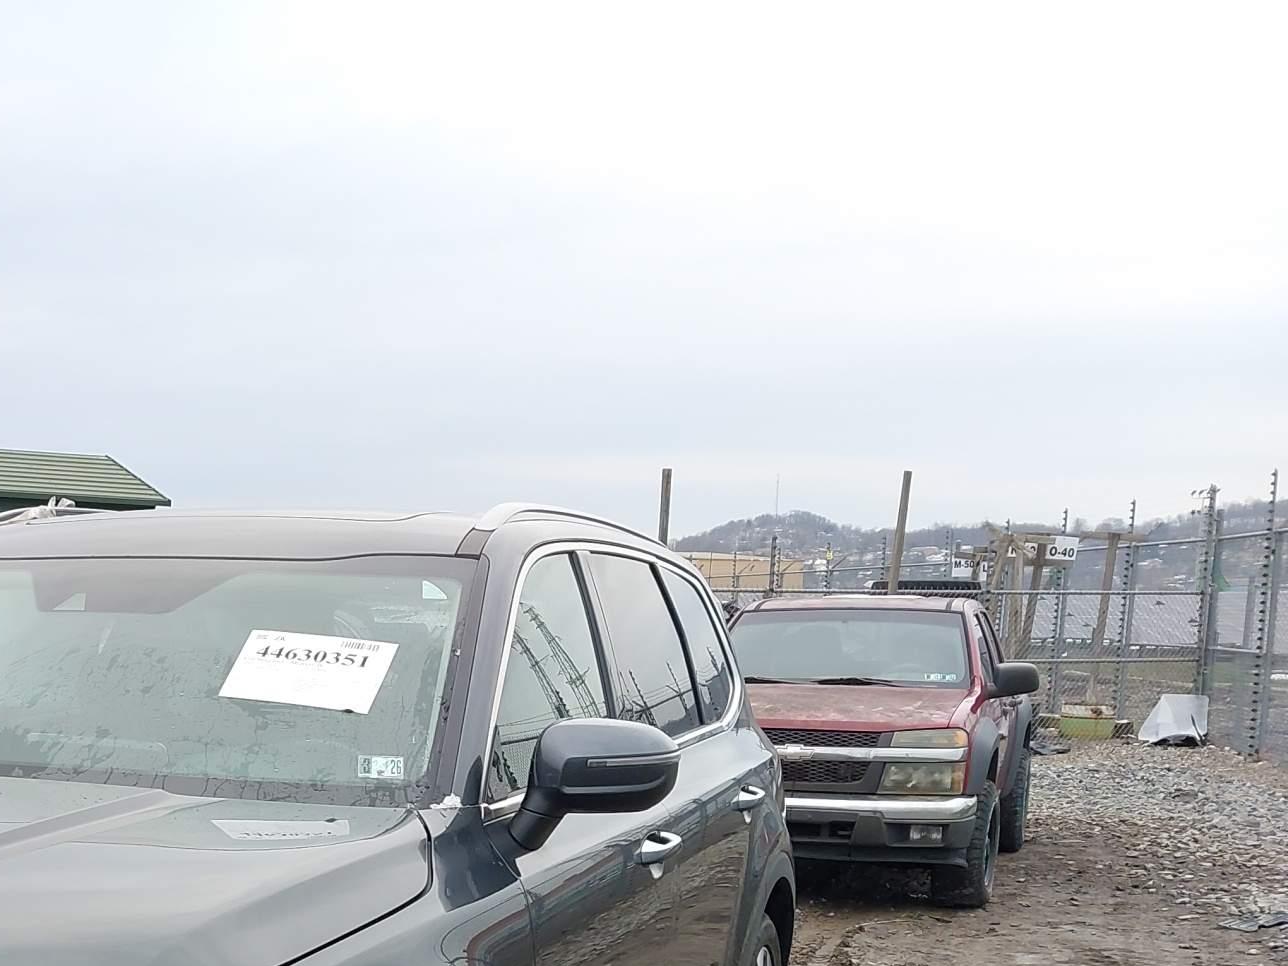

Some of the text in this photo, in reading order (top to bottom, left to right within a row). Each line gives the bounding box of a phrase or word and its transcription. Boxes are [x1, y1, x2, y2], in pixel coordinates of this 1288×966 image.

[1049, 545, 1075, 558] O-40
[954, 560, 975, 569] M-50
[256, 645, 370, 668] 44630351
[390, 759, 402, 775] 26
